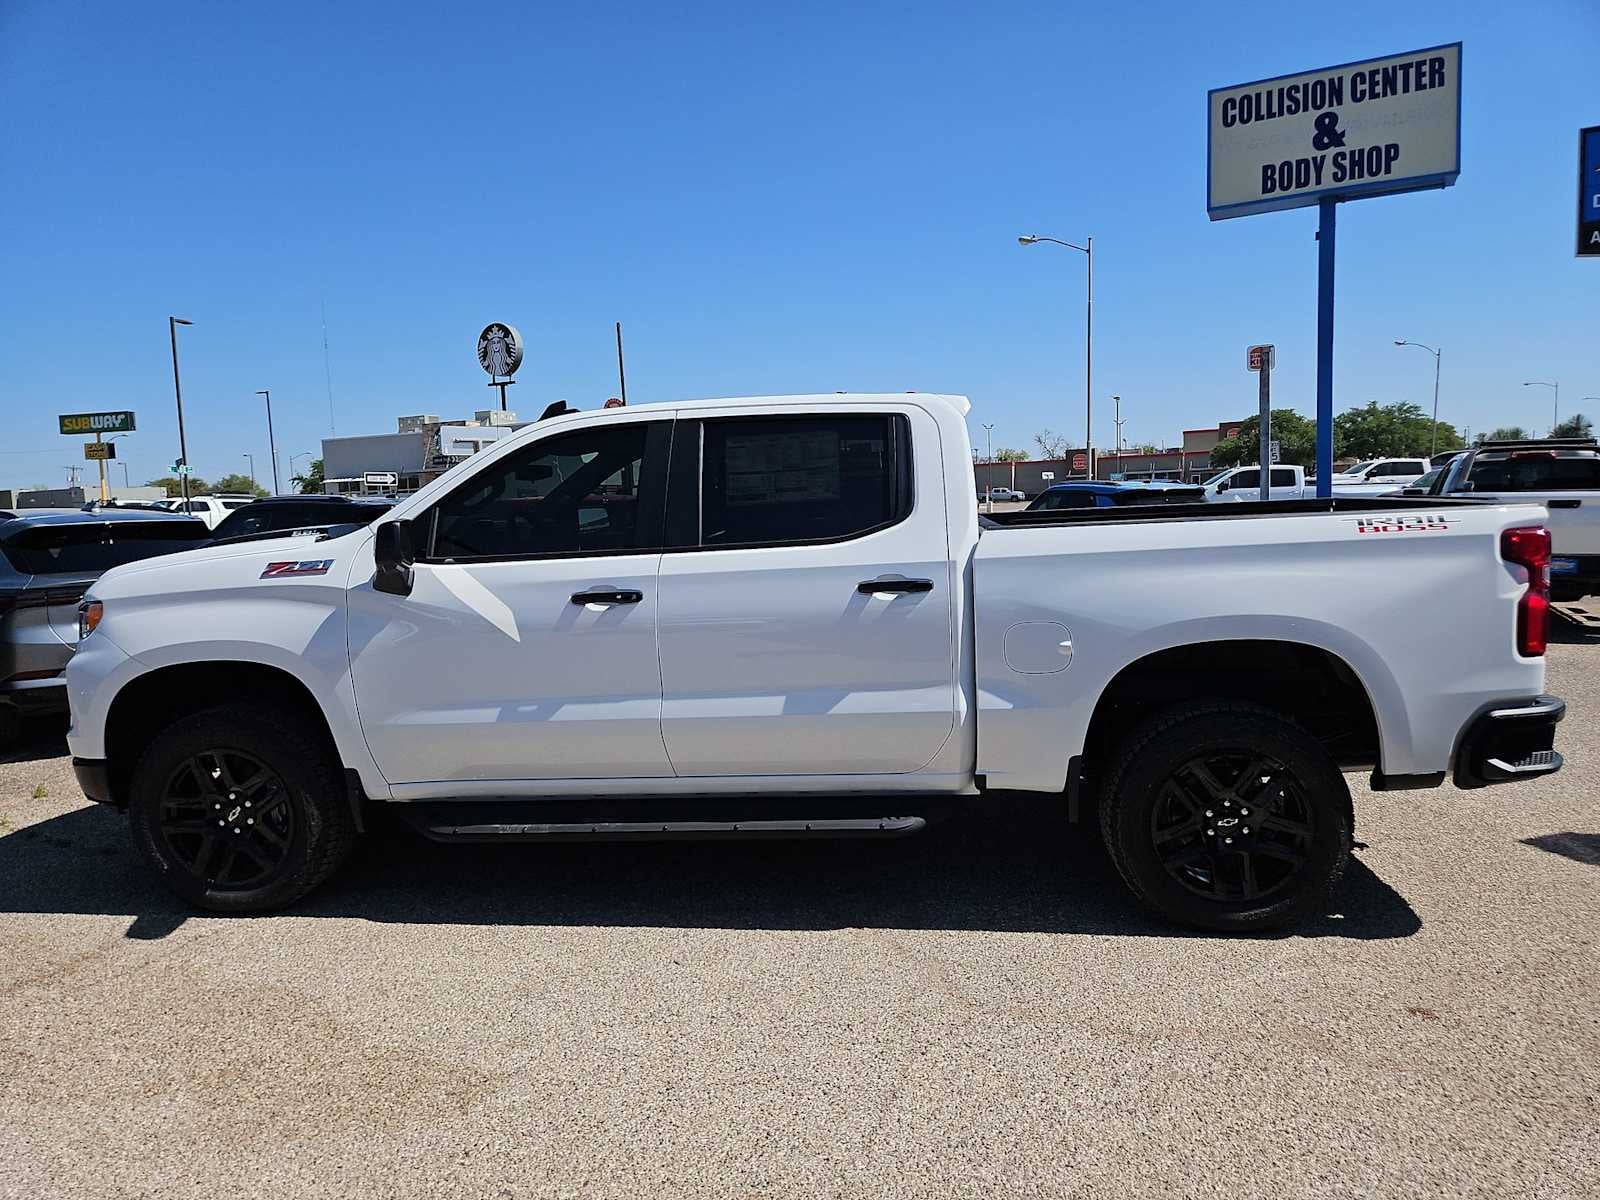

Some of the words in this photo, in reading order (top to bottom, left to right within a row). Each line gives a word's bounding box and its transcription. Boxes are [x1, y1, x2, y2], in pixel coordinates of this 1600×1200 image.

[1222, 75, 1344, 128] COLLISION
[1350, 56, 1446, 104] CENTER
[1312, 111, 1346, 151] &
[1261, 154, 1327, 195] BODY
[1332, 143, 1400, 183] SHOP
[63, 414, 123, 431] SUBWAY
[1342, 515, 1461, 526] TRAIL
[1358, 523, 1448, 533] BOSS
